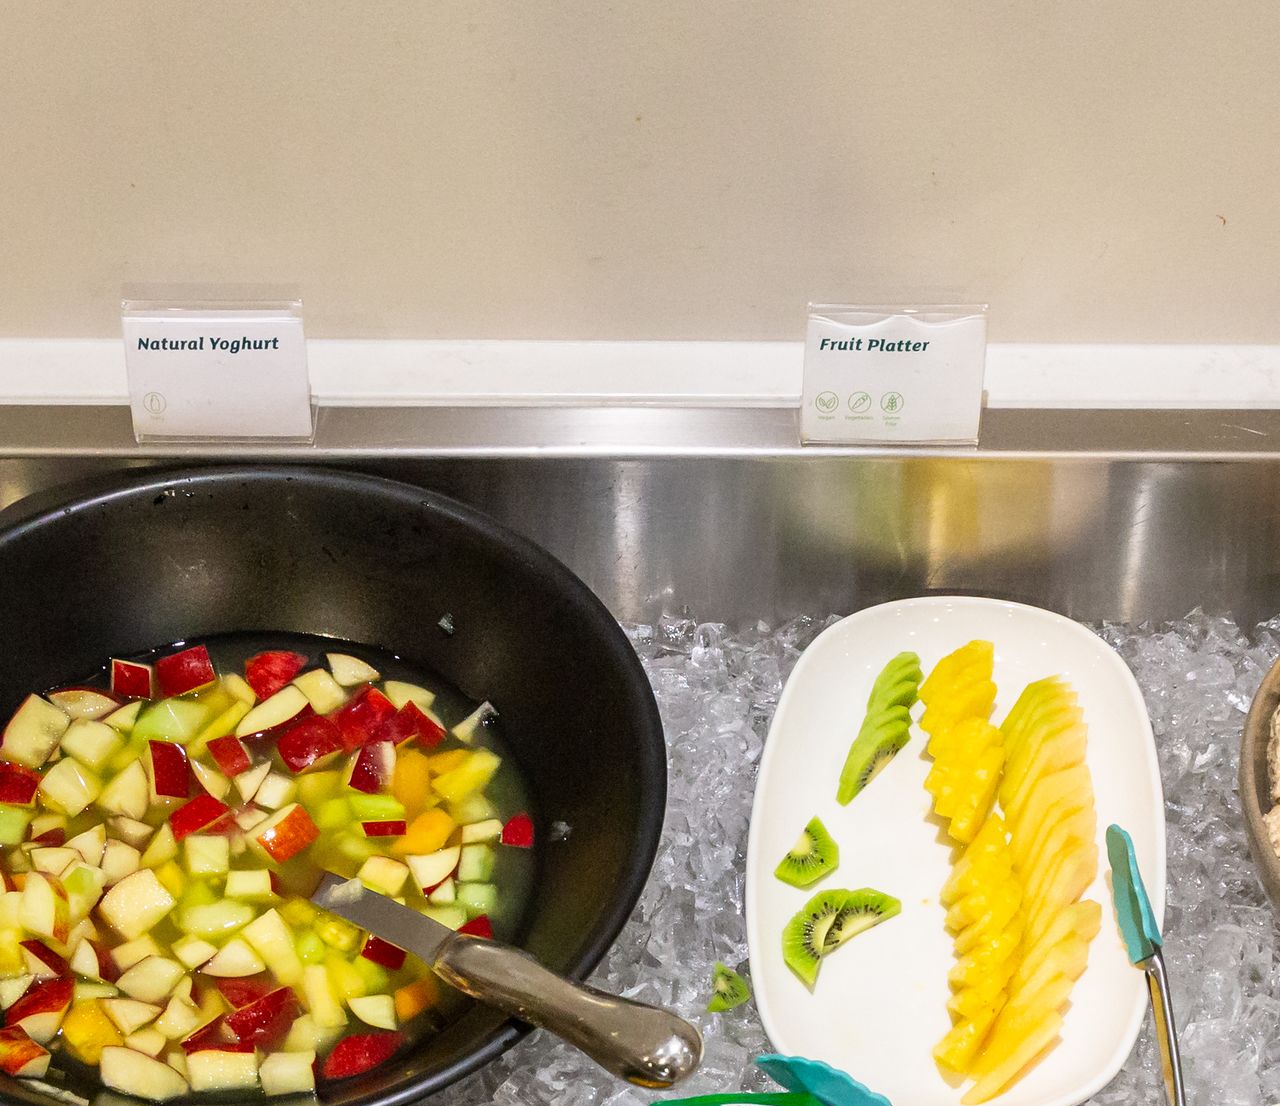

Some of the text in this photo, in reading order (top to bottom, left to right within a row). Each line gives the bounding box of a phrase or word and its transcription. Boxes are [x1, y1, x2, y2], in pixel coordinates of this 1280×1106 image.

[138, 337, 279, 353] Natural Yoghurt
[820, 337, 930, 352] Fruit Platter
